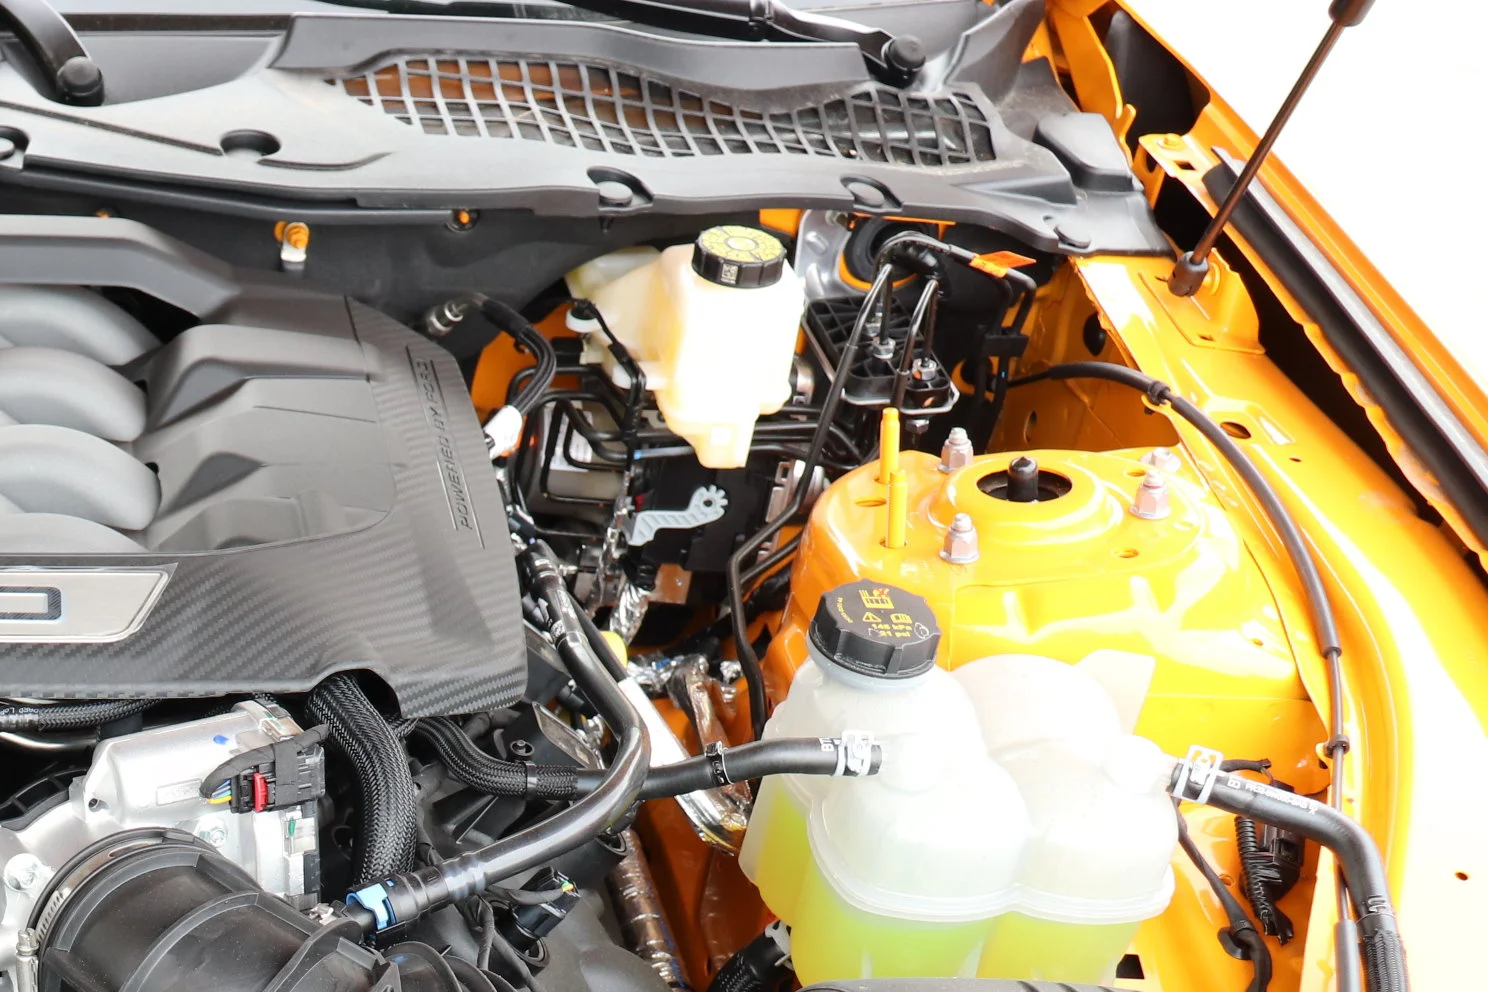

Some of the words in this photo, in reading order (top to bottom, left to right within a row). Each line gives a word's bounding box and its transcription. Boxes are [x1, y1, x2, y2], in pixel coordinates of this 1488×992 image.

[416, 359, 437, 402] FORD
[428, 405, 448, 431] BY
[439, 434, 473, 530] POWERED
